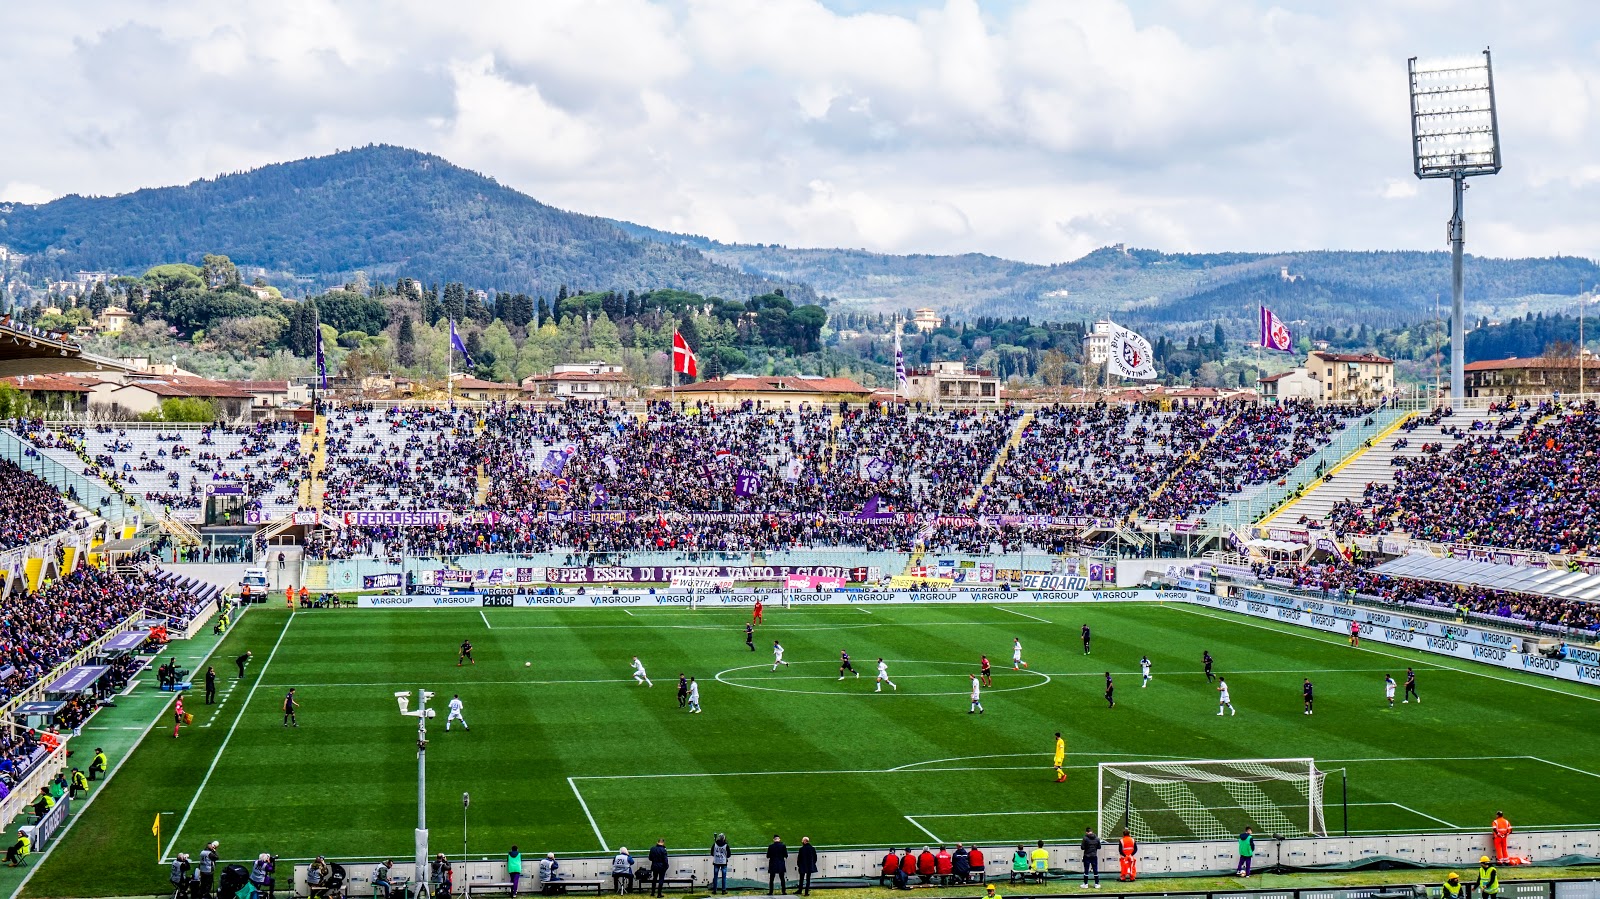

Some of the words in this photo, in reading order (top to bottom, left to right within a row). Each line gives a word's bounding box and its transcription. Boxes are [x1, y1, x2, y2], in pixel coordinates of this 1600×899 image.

[359, 512, 437, 524] FEDELISSIMI
[560, 568, 588, 581] PER
[594, 567, 634, 581] ESSER
[640, 567, 655, 581] DI
[662, 567, 720, 580] FIRENZE
[726, 567, 774, 579] VANTO
[780, 567, 790, 578] E
[796, 567, 851, 581] GLORIA
[1023, 575, 1041, 587] BE
[1040, 576, 1087, 591] BOARD
[656, 595, 705, 604] VARGROUP
[720, 595, 769, 604] VARGROUP
[783, 595, 831, 604] VARGROUP
[847, 593, 895, 602] VARGROUP
[909, 593, 957, 602] VARGROUP
[971, 592, 1019, 601] VARGROUP
[1032, 592, 1079, 601] VARGROUP
[1092, 591, 1139, 600] VARGROUP
[371, 597, 413, 605] VARGROUP
[434, 597, 475, 605] VARGROUP
[485, 596, 513, 605] 21:06
[525, 596, 576, 605] VARGROUP
[590, 596, 641, 605] VARGROUP
[1384, 627, 1414, 644] VARGROUP
[1481, 631, 1512, 646] VARGROUP
[1426, 635, 1459, 651] VARGROUP
[1471, 644, 1507, 661] VARGROUP
[1521, 654, 1560, 672] VARGROUP
